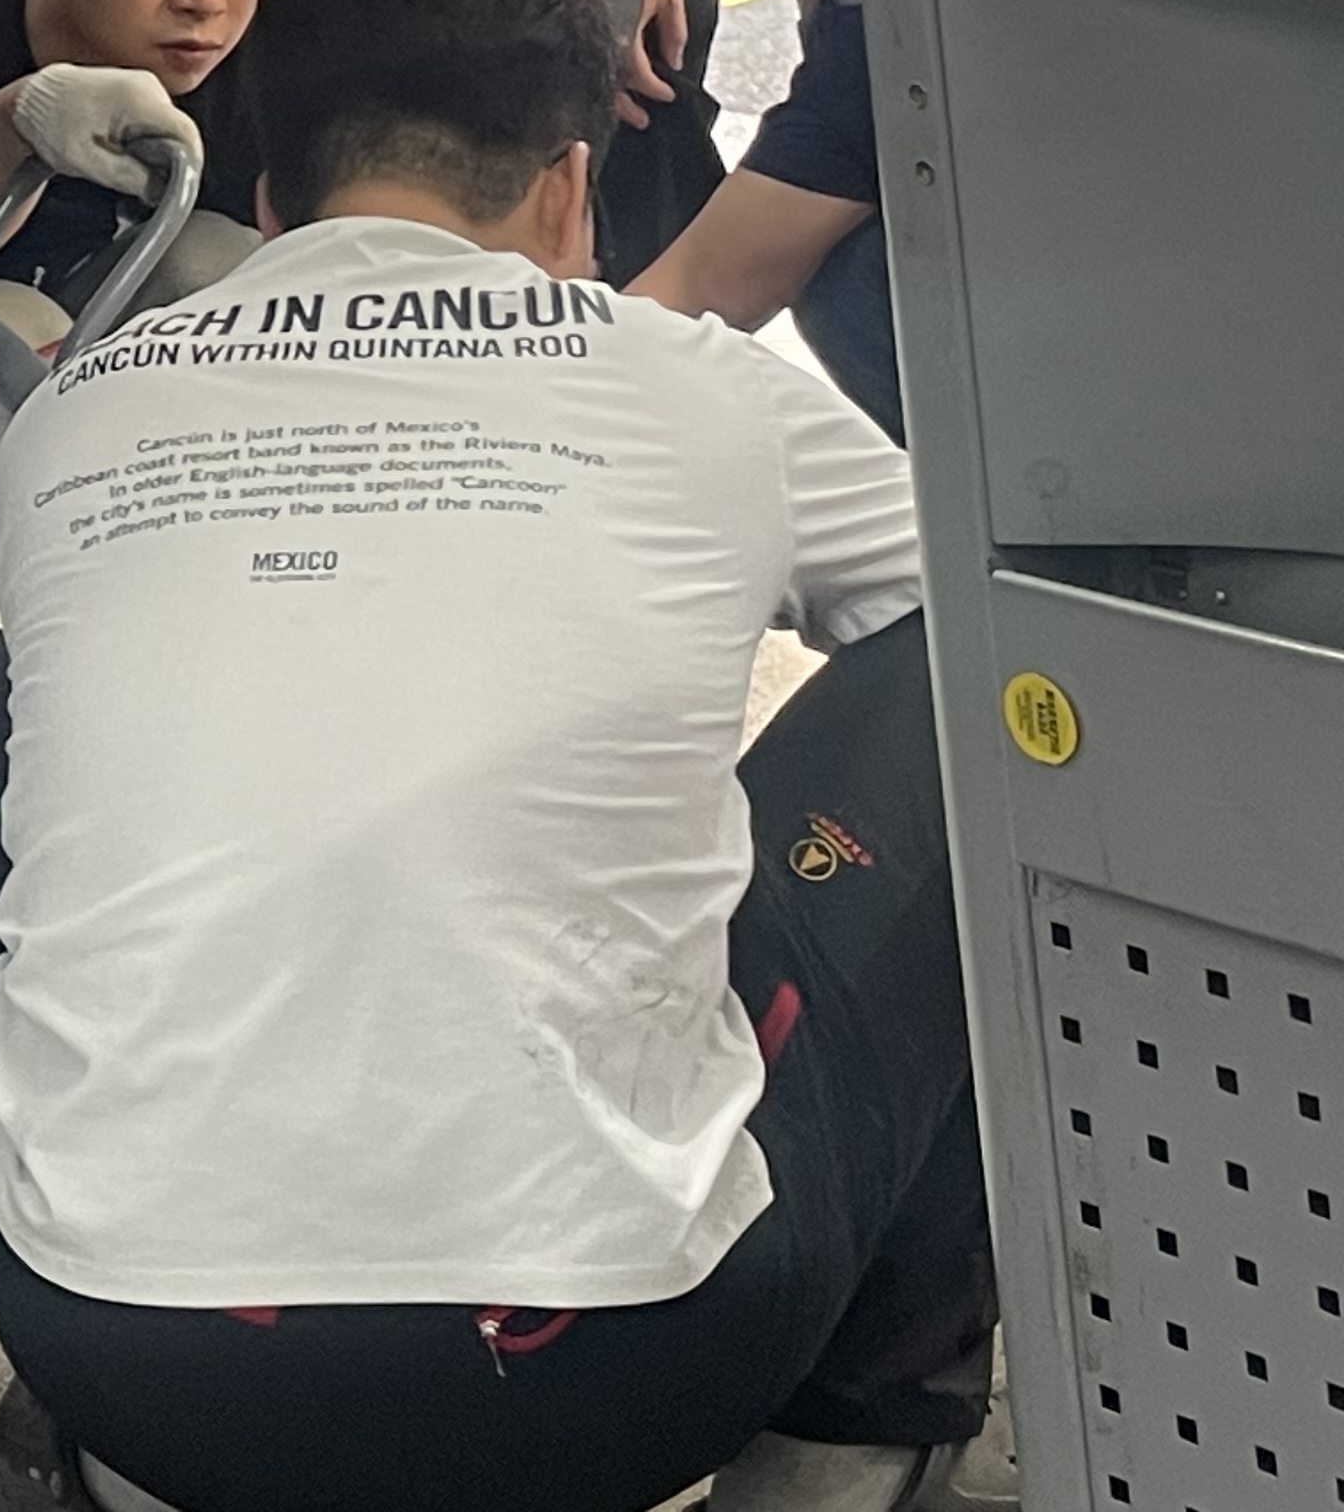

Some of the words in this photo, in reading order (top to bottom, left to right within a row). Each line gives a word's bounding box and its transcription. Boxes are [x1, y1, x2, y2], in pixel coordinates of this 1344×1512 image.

[258, 294, 325, 334] IN
[192, 340, 317, 364] WITHIN
[328, 337, 504, 361] QUINTANA
[514, 333, 588, 358] ROO
[220, 429, 238, 443] is
[244, 425, 284, 444] just
[291, 423, 350, 437] north
[354, 421, 378, 436] of
[124, 453, 176, 476] coast
[181, 448, 241, 465] resort
[309, 441, 380, 455] known
[386, 441, 411, 453] as
[420, 438, 456, 452] the
[464, 436, 542, 454] Riviera
[132, 472, 184, 493] older
[69, 514, 96, 535] the
[151, 490, 208, 508] name
[214, 486, 232, 500] is
[239, 481, 356, 499] sometimes
[363, 477, 445, 494] spelled
[79, 533, 101, 552] an
[104, 511, 177, 542] attempt
[183, 509, 204, 524] to
[209, 504, 282, 521] convey
[288, 501, 324, 516] the
[331, 498, 399, 514] sound
[404, 496, 429, 511] of
[436, 496, 472, 511] the
[251, 549, 339, 572] MEXICO
